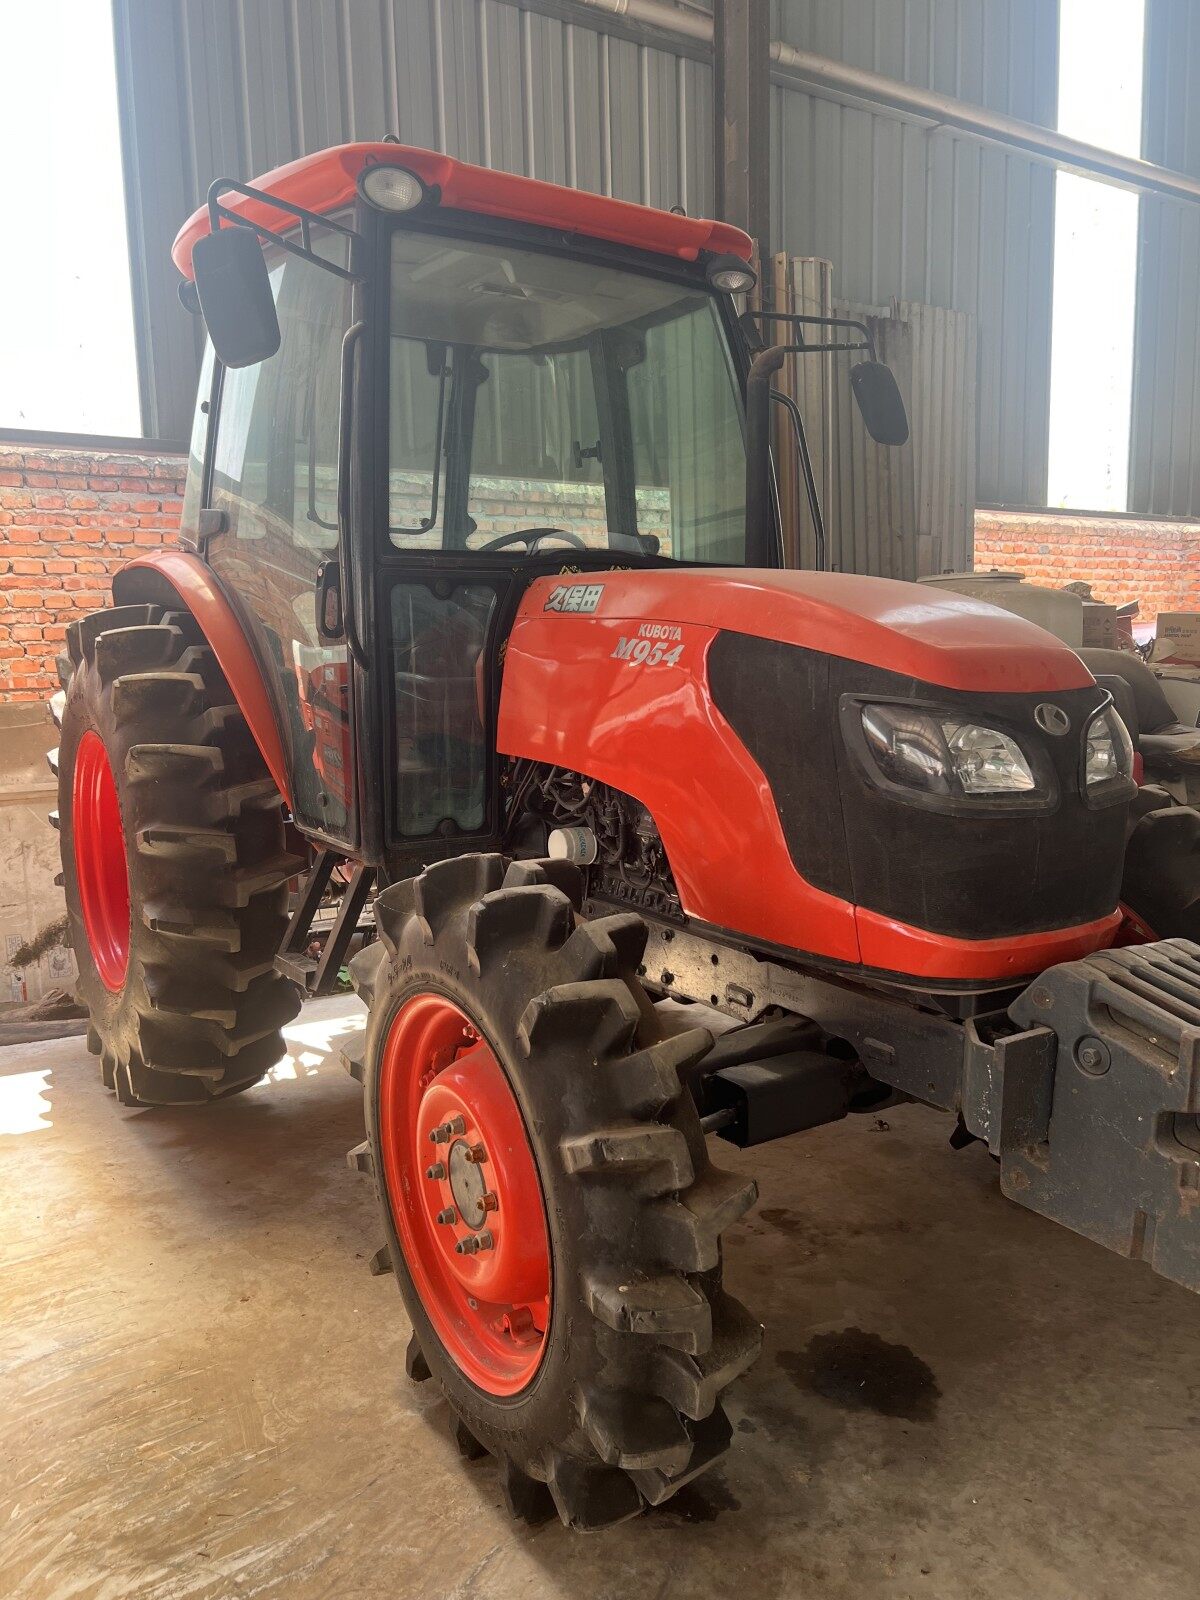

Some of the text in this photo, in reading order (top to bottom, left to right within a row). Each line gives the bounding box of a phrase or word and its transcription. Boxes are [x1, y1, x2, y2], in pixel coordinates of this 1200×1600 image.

[543, 584, 606, 614] 久保田
[638, 624, 682, 641] KUBOTA
[610, 636, 685, 667] M954
